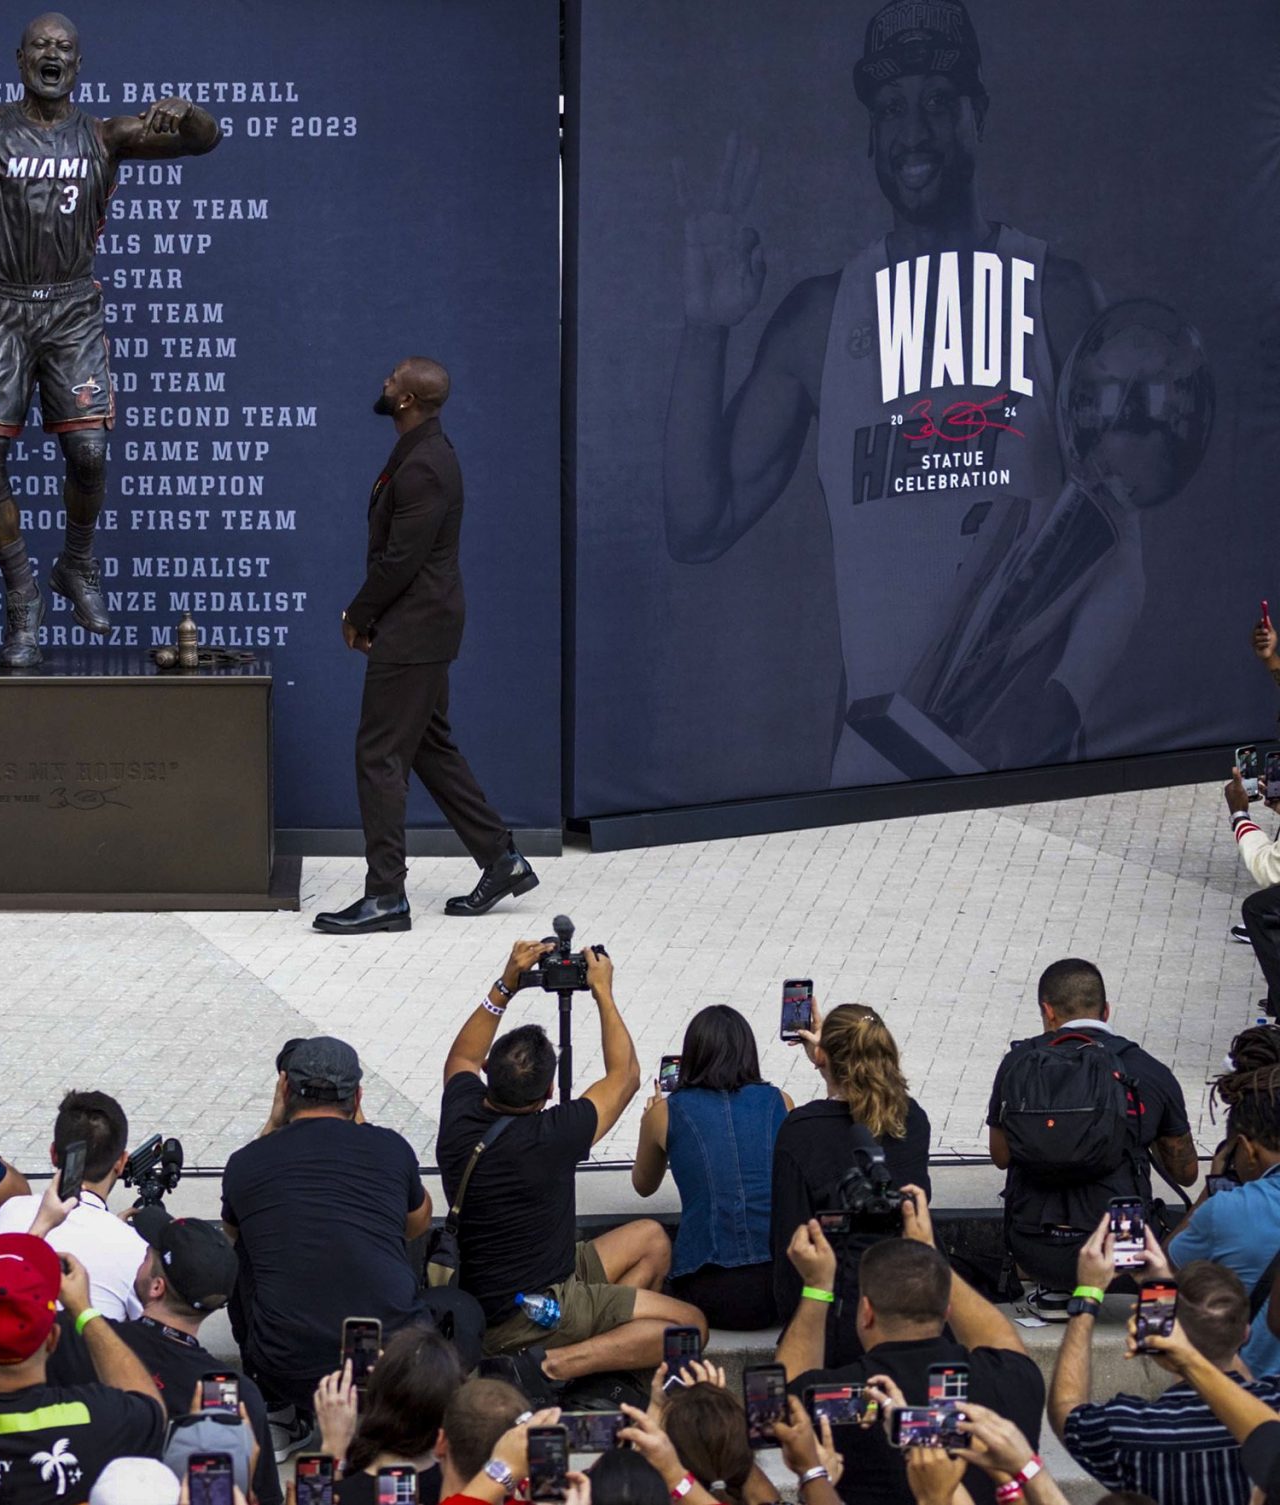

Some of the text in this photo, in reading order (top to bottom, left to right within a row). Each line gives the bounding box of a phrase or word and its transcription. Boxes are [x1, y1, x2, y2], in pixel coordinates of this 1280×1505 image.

[122, 82, 299, 103] BASKETBALL
[247, 117, 279, 137] OF
[291, 117, 358, 137] 2023
[6, 157, 88, 178] MIAMI
[60, 185, 79, 214] 3
[193, 199, 269, 220] TEAM
[153, 234, 212, 254] MVP
[103, 269, 183, 289] -STAR
[104, 304, 136, 323] ST
[148, 303, 224, 323] TEAM
[875, 251, 1035, 404] WADE
[114, 338, 148, 358] ND
[161, 338, 237, 358] TEAM
[150, 372, 226, 392] TEAM
[125, 406, 230, 427] SECOND
[242, 406, 318, 427] TEAM
[891, 406, 1017, 425] 20 24
[125, 441, 199, 461] GAME
[212, 441, 270, 461] MVP
[921, 450, 984, 470] STATUE
[121, 475, 264, 495] CHAMPION
[894, 469, 1010, 493] CELEBRATION
[130, 510, 210, 530] FIRST
[221, 510, 297, 530] TEAM
[132, 557, 270, 577] MEDALIST
[52, 592, 156, 612] BNZE
[169, 592, 307, 612] MEDALIST
[38, 626, 289, 646] BRONZE MDALIST
[28, 762, 67, 782] MY
